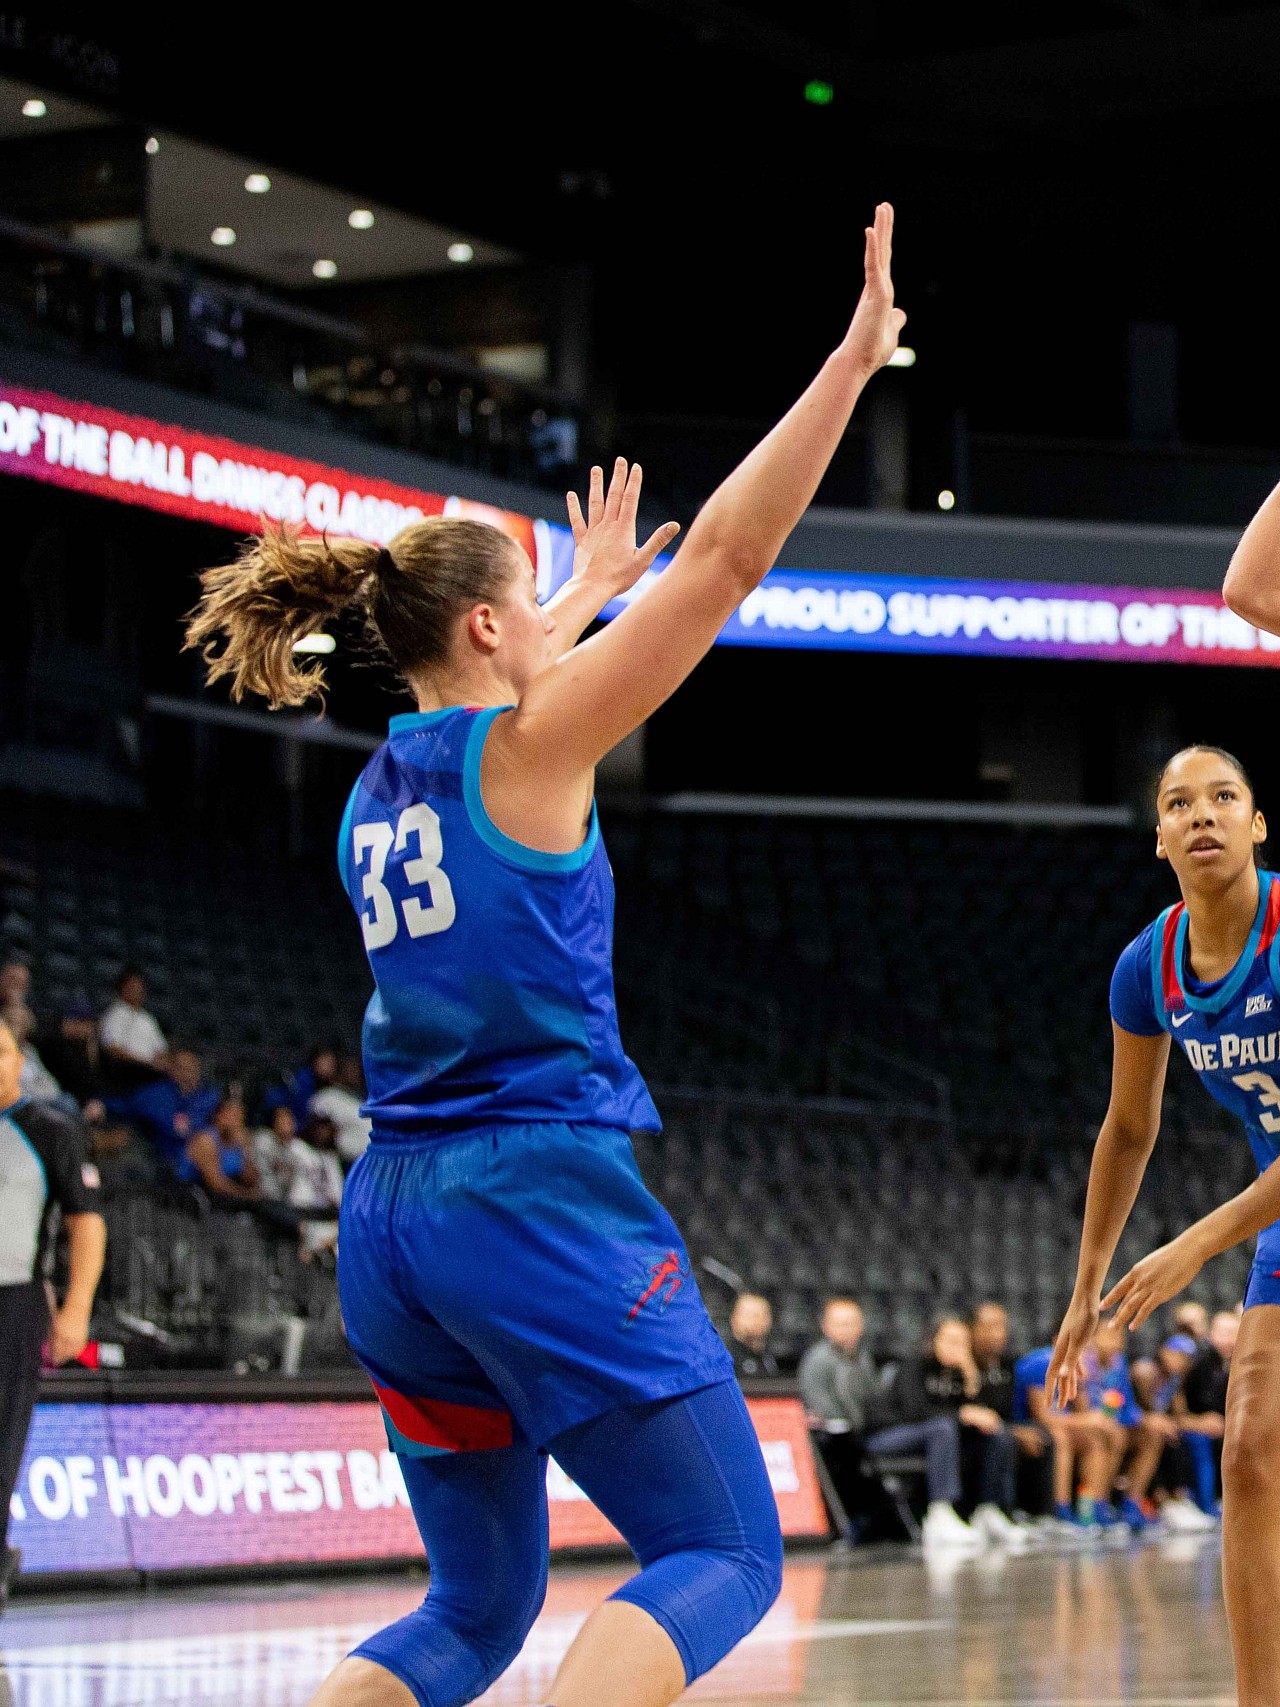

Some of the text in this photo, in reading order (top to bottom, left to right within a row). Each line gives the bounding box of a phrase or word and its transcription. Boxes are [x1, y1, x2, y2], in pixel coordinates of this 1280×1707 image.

[0, 400, 40, 457] OF
[40, 411, 109, 477] THE
[109, 430, 192, 498] BALL
[738, 586, 887, 635] PROUD
[886, 591, 1120, 646] SUPPORTER
[1119, 602, 1179, 647] OF
[353, 801, 456, 951] 33
[28, 1455, 99, 1521] OF
[102, 1451, 345, 1518] HOOPFEST
[346, 1448, 412, 1511] BA
